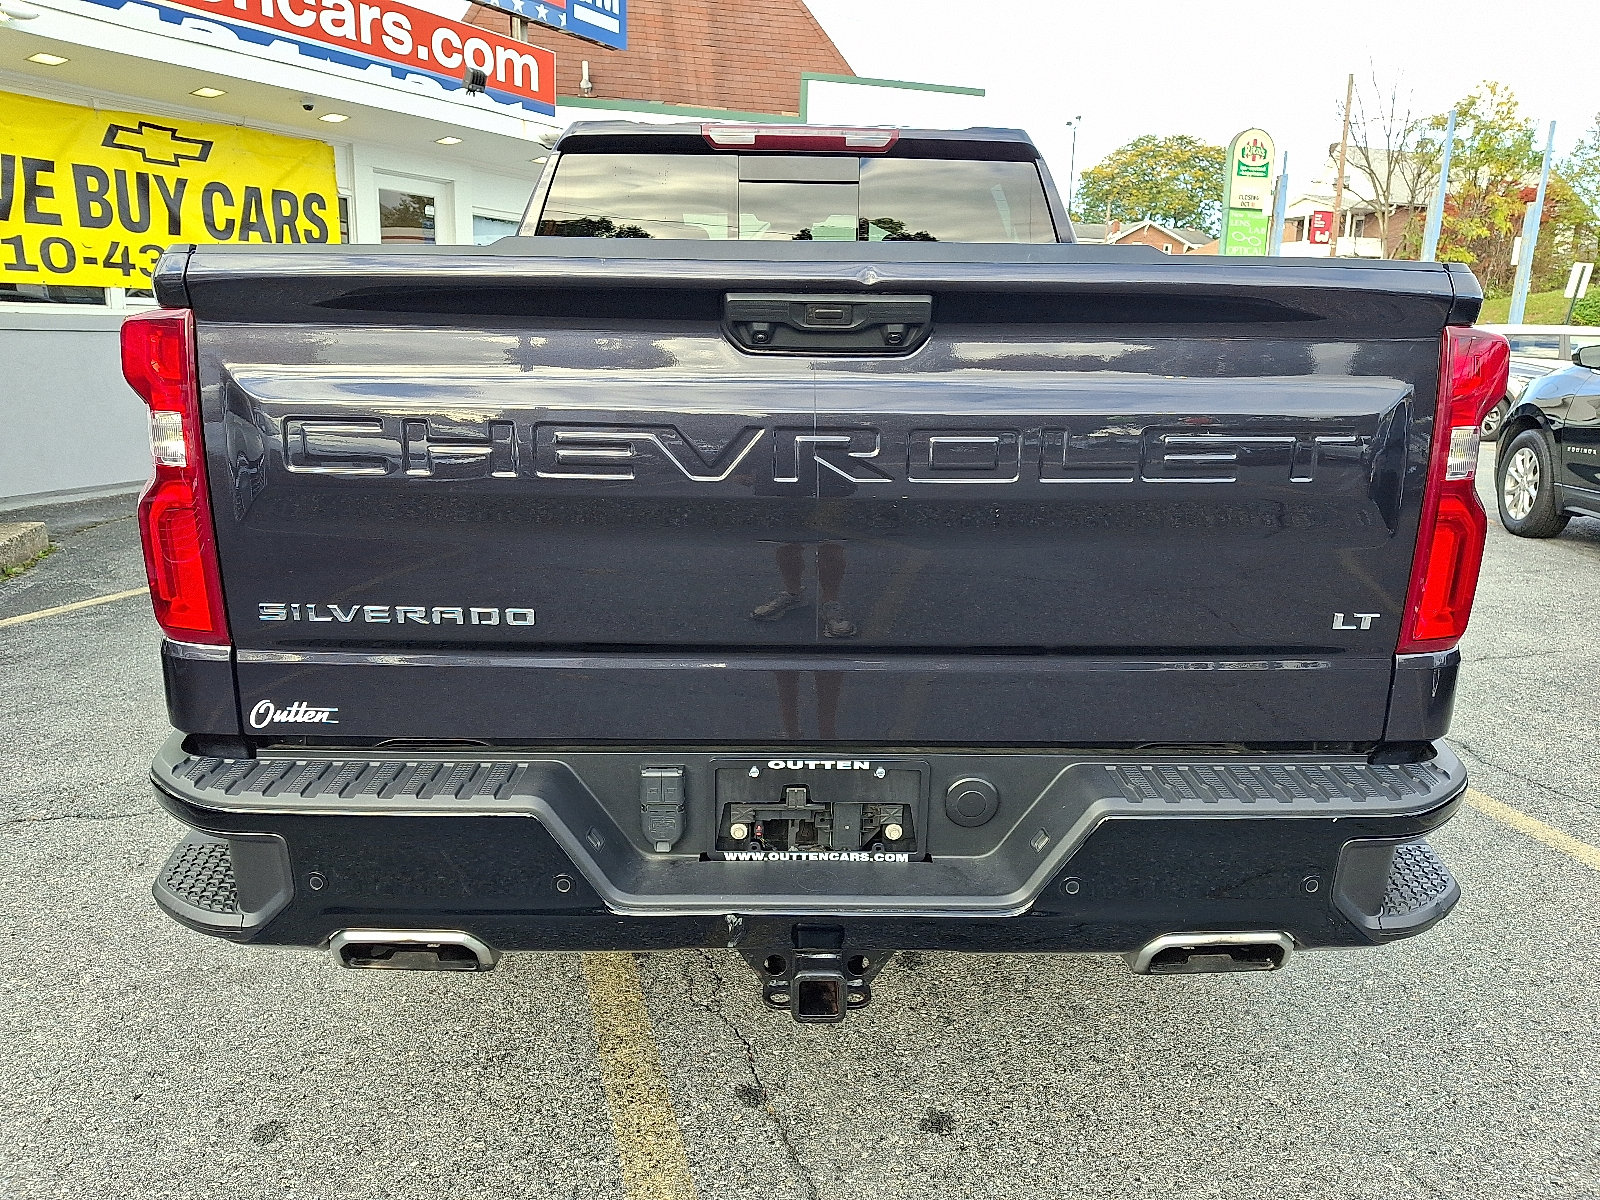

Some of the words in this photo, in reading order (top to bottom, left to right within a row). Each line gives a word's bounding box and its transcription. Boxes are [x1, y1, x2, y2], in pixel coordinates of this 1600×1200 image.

[71, 163, 188, 236] BUY
[201, 181, 329, 244] CARS
[281, 414, 1357, 484] CHEVROLET
[1567, 446, 1597, 455] EQUINOX
[258, 602, 536, 626] SILVERADO
[1332, 612, 1381, 630] LT
[249, 699, 340, 729] Outten
[767, 760, 870, 770] OUTTEN
[723, 851, 909, 862] WWW.OUTTENCARS.COM
